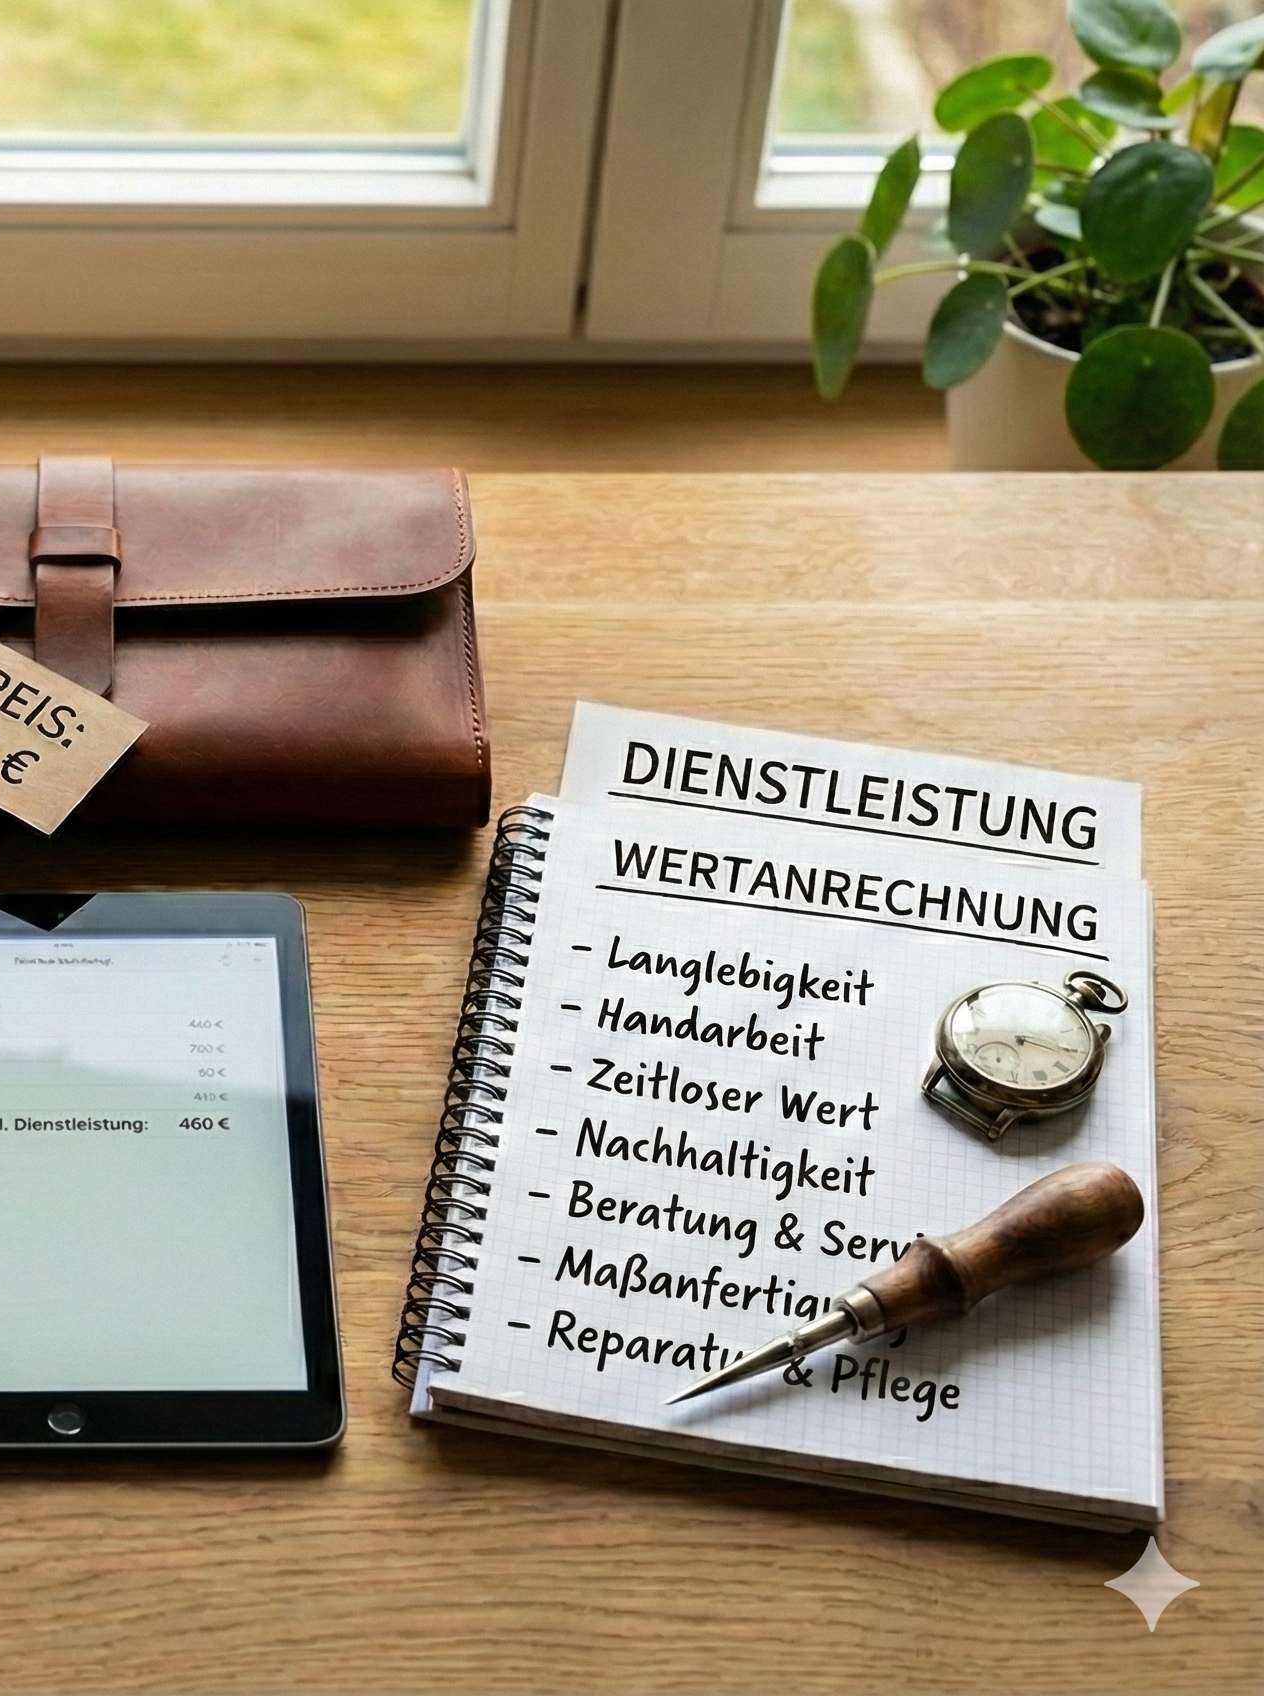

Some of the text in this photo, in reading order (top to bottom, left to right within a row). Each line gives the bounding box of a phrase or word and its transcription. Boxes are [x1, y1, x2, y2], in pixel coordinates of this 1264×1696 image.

[0, 750, 40, 784] €
[622, 741, 1097, 850] DIENSTLEISTUNG
[614, 839, 1097, 942] WERTANRECHNUNG
[607, 935, 875, 1010] Langlebigkeit
[597, 997, 825, 1061] Handarbeit
[14, 1117, 149, 1134] Dienstleistung:
[178, 1117, 214, 1131] 460
[217, 1117, 230, 1130] €
[586, 1058, 763, 1114] Zeitloser
[781, 1085, 879, 1131] Wert
[575, 1117, 876, 1201] Nachhaltigkeit
[568, 1180, 757, 1259] Beratung
[774, 1212, 805, 1252] &
[820, 1220, 924, 1263] Serv
[547, 1309, 744, 1373] Reparatu
[831, 1352, 960, 1423] Pflege
